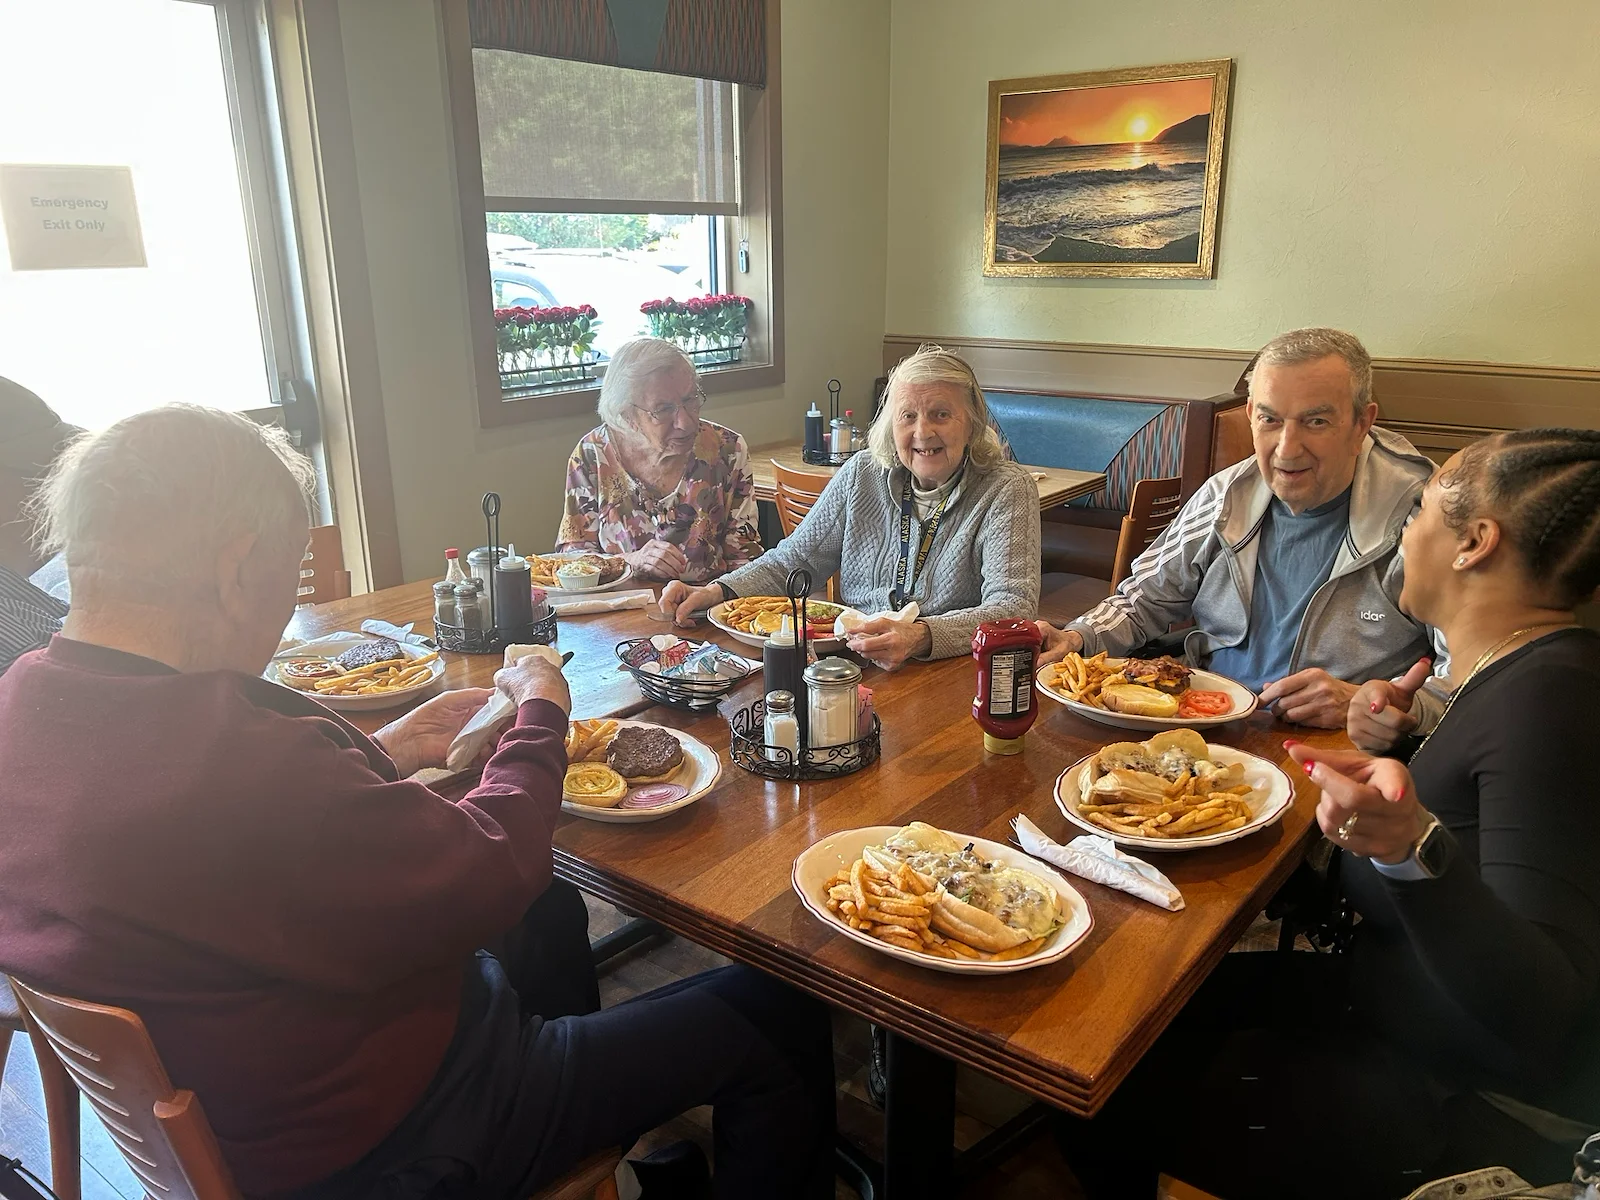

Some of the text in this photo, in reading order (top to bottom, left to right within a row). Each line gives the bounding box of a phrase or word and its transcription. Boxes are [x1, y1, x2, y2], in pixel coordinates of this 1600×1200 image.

[30, 197, 108, 210] Emergency
[43, 219, 106, 232] Exit Only
[901, 514, 910, 543] ALASKA
[897, 556, 907, 585] ALASKA
